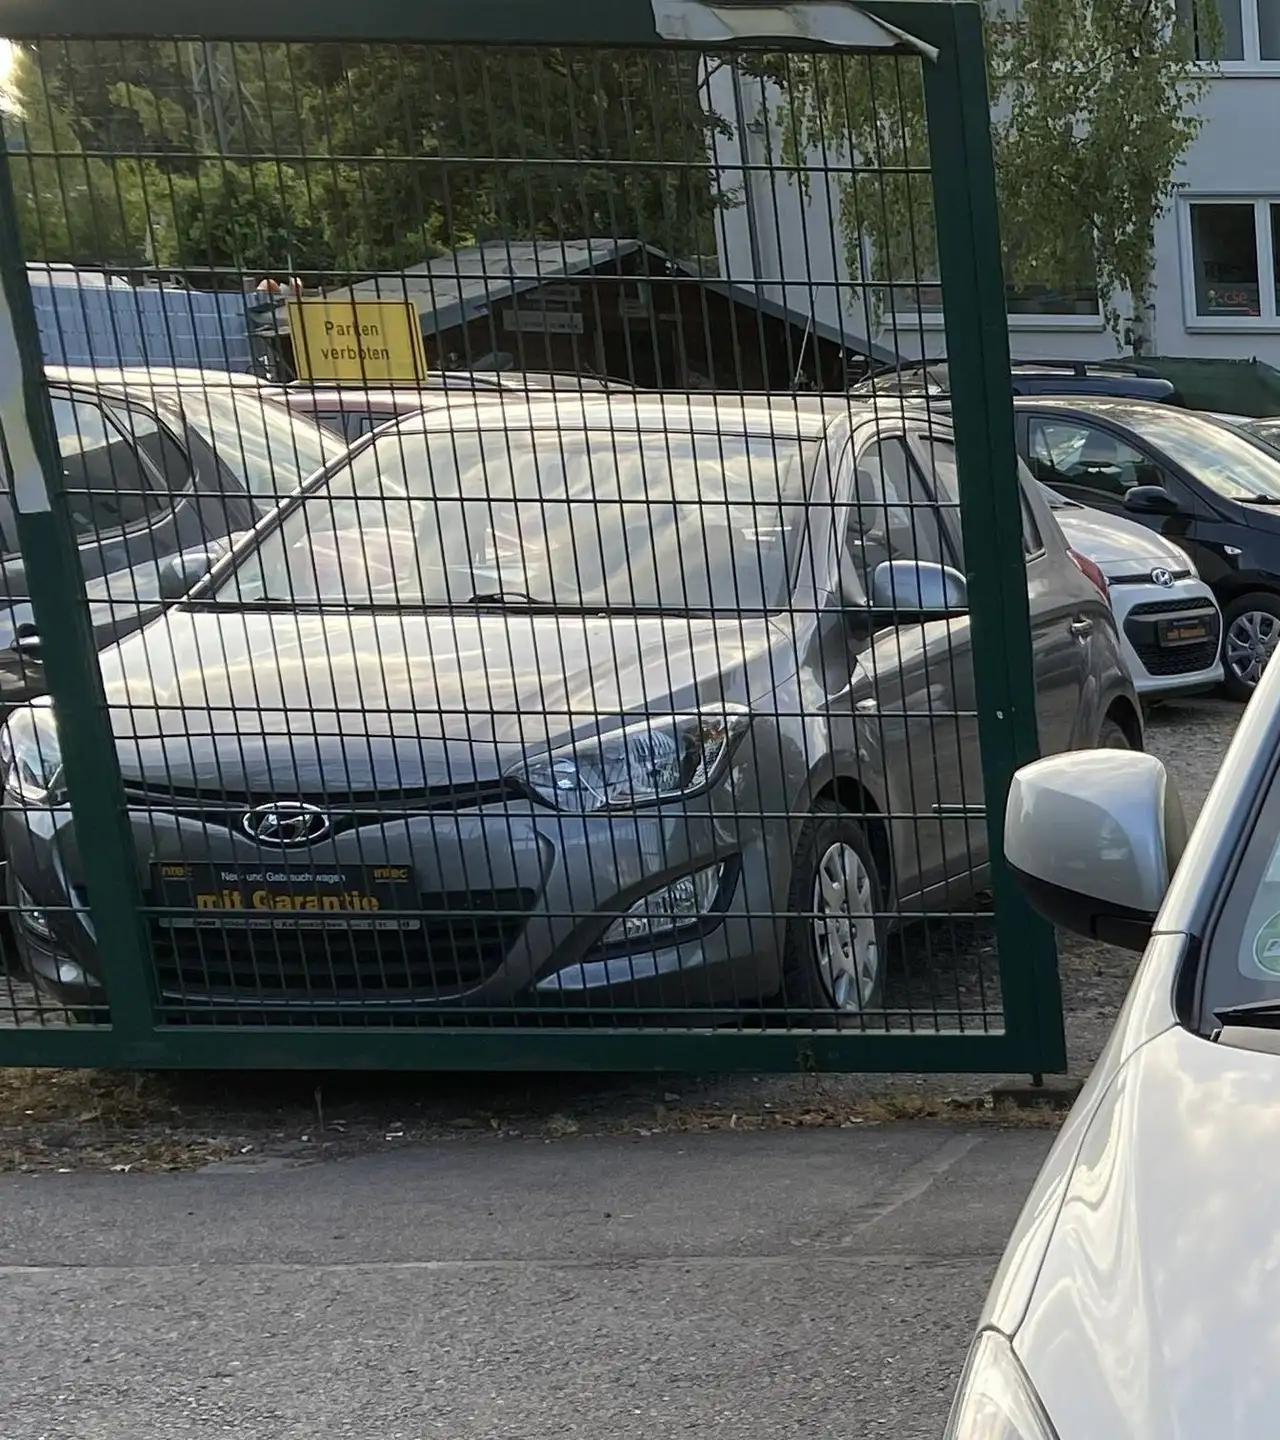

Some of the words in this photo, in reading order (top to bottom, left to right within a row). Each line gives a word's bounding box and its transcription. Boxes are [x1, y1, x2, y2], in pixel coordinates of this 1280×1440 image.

[321, 345, 390, 360] verboten
[197, 890, 243, 910] mit
[253, 890, 380, 911] Garantie
